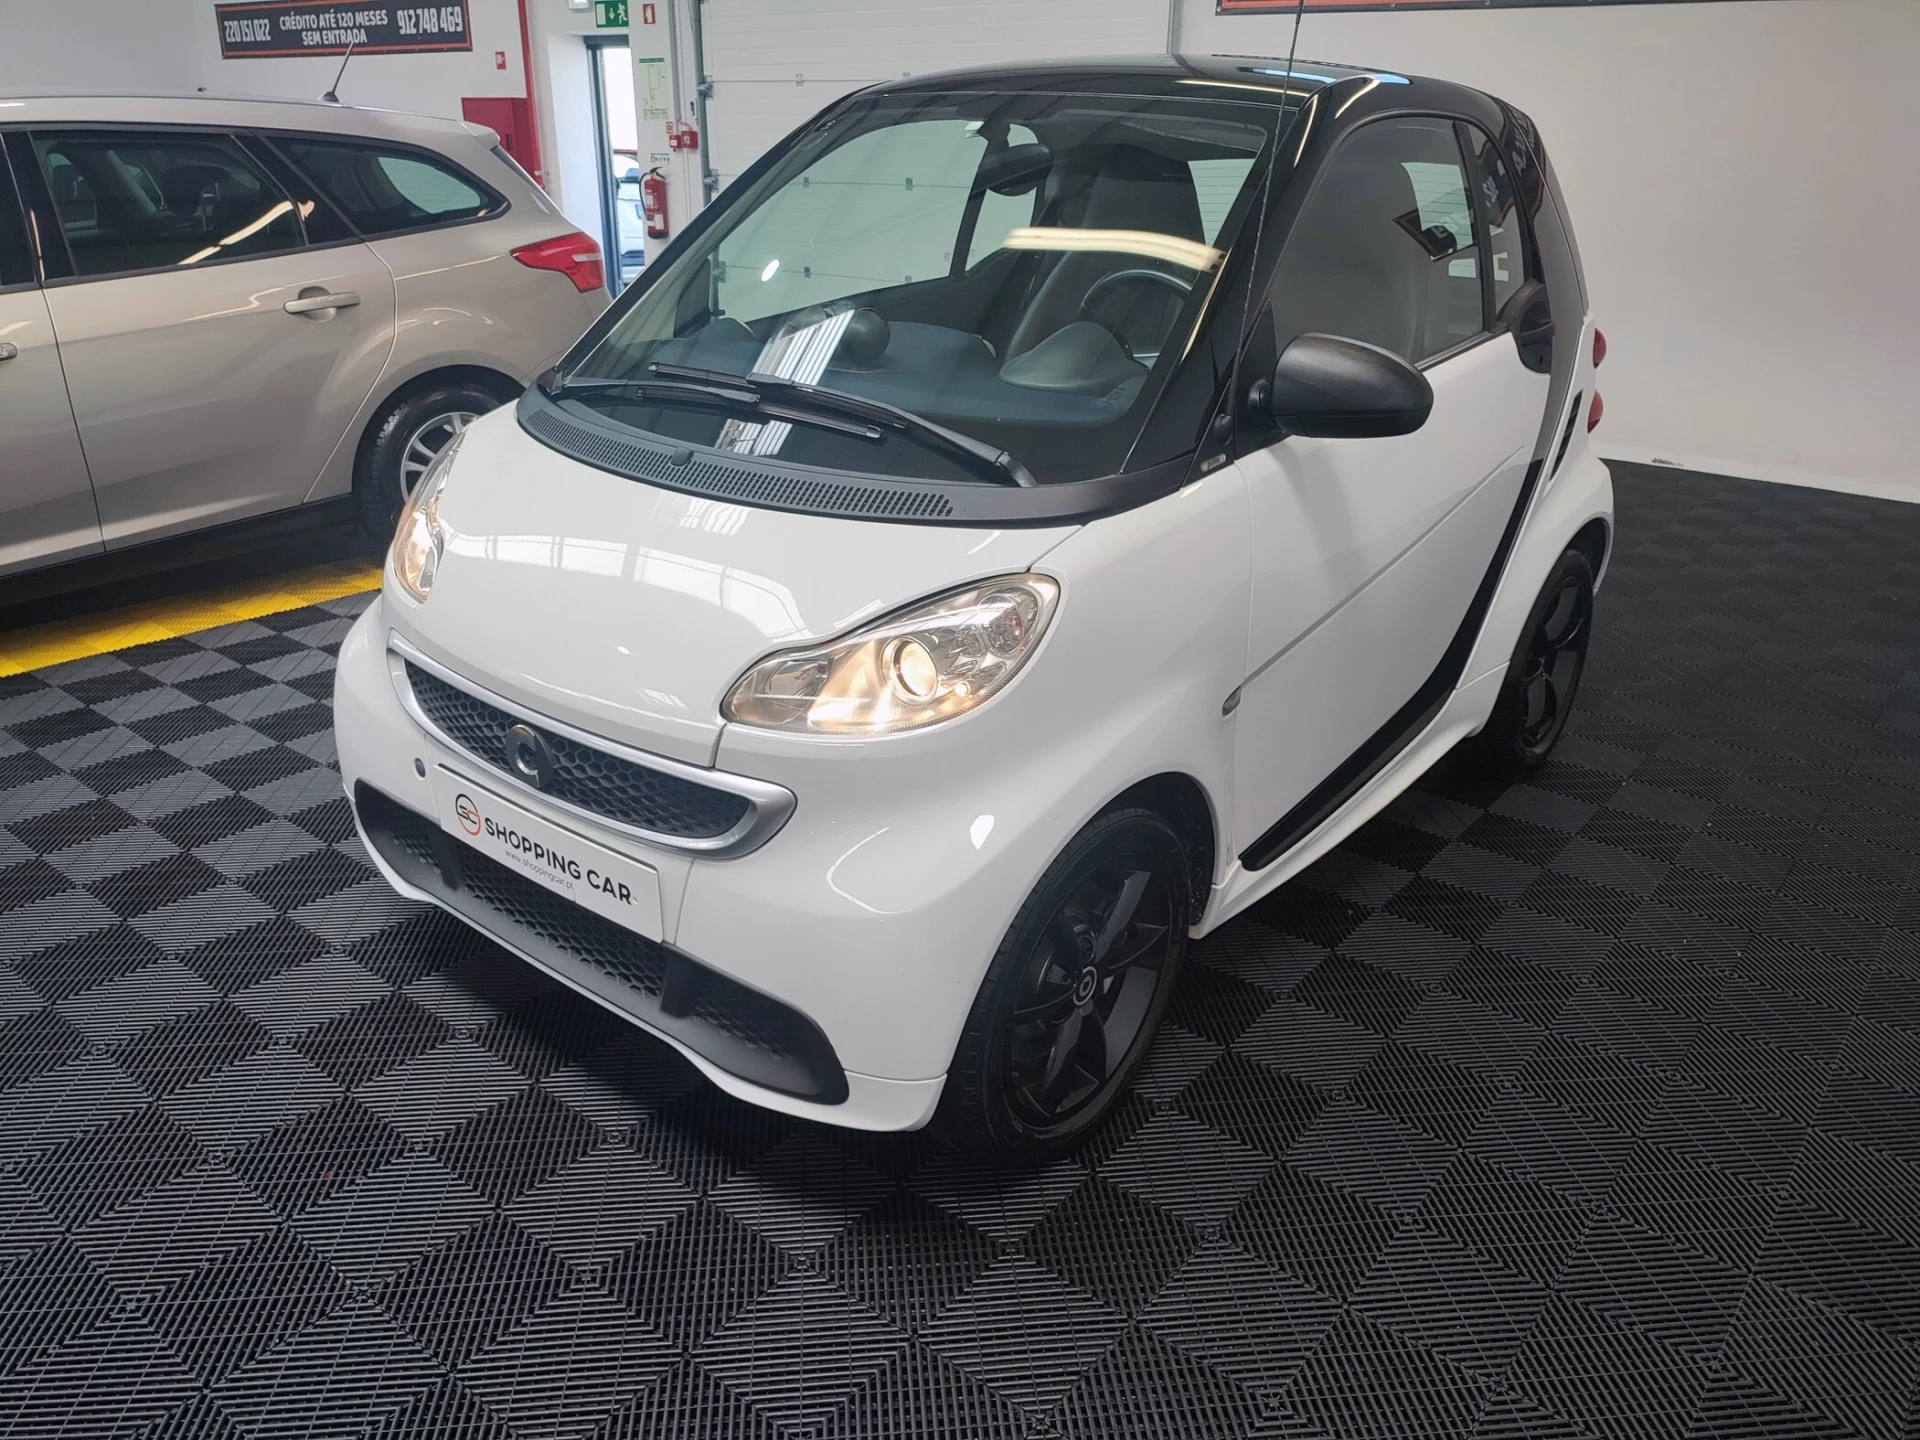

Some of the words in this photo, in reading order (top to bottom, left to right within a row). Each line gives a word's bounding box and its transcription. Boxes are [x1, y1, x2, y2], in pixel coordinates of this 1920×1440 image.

[279, 11, 318, 30] CRÉDITO
[319, 9, 337, 28] ATÉ
[336, 12, 354, 28] 120
[355, 9, 389, 27] MESES
[396, 9, 418, 35] 912
[416, 7, 439, 34] 748
[440, 6, 464, 33] 469
[301, 30, 322, 46] SEM
[322, 28, 368, 45] ENTRADA
[484, 817, 582, 881] SHOPPING
[586, 868, 633, 906] CAR
